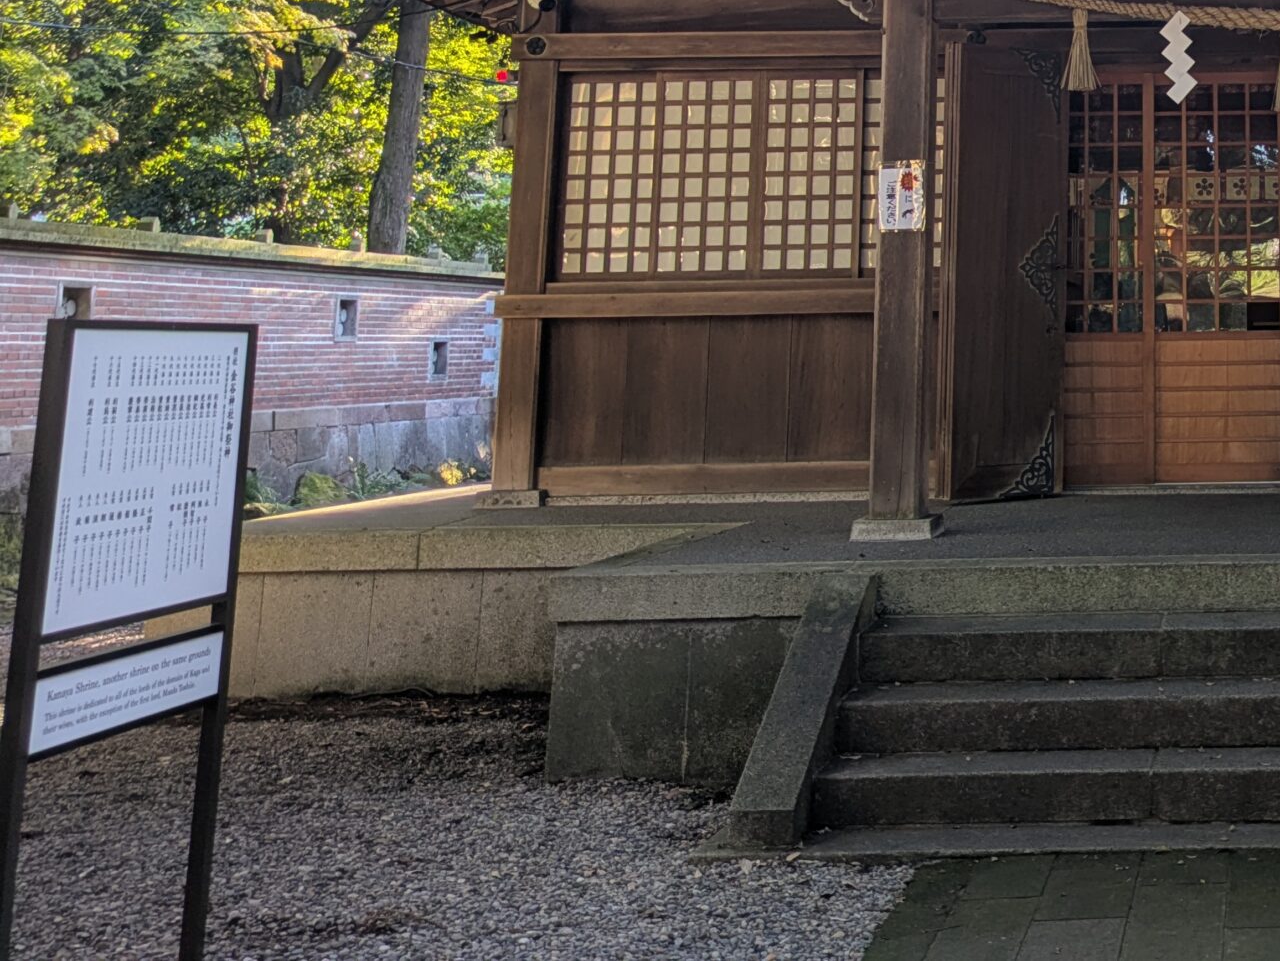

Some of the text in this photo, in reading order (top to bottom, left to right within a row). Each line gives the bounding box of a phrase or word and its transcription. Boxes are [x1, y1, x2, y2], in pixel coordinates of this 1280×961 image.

[44, 712, 57, 721] This
[58, 707, 75, 717] shrine
[83, 695, 107, 709] dedicated
[122, 688, 128, 697] of
[138, 683, 150, 692] lords
[151, 679, 157, 689] of
[166, 674, 182, 684] domain
[183, 670, 189, 678] of
[189, 669, 200, 677] Kaga
[46, 646, 210, 702] Kanaya Shrine, another shrine on the same grounds
[42, 725, 56, 735] their
[58, 721, 73, 729] wives,
[75, 715, 87, 724] with
[89, 712, 97, 720] the
[99, 705, 122, 717] exception
[123, 700, 129, 709] of
[139, 695, 149, 704] first
[150, 691, 160, 700] lord,
[162, 686, 177, 696] Maeda
